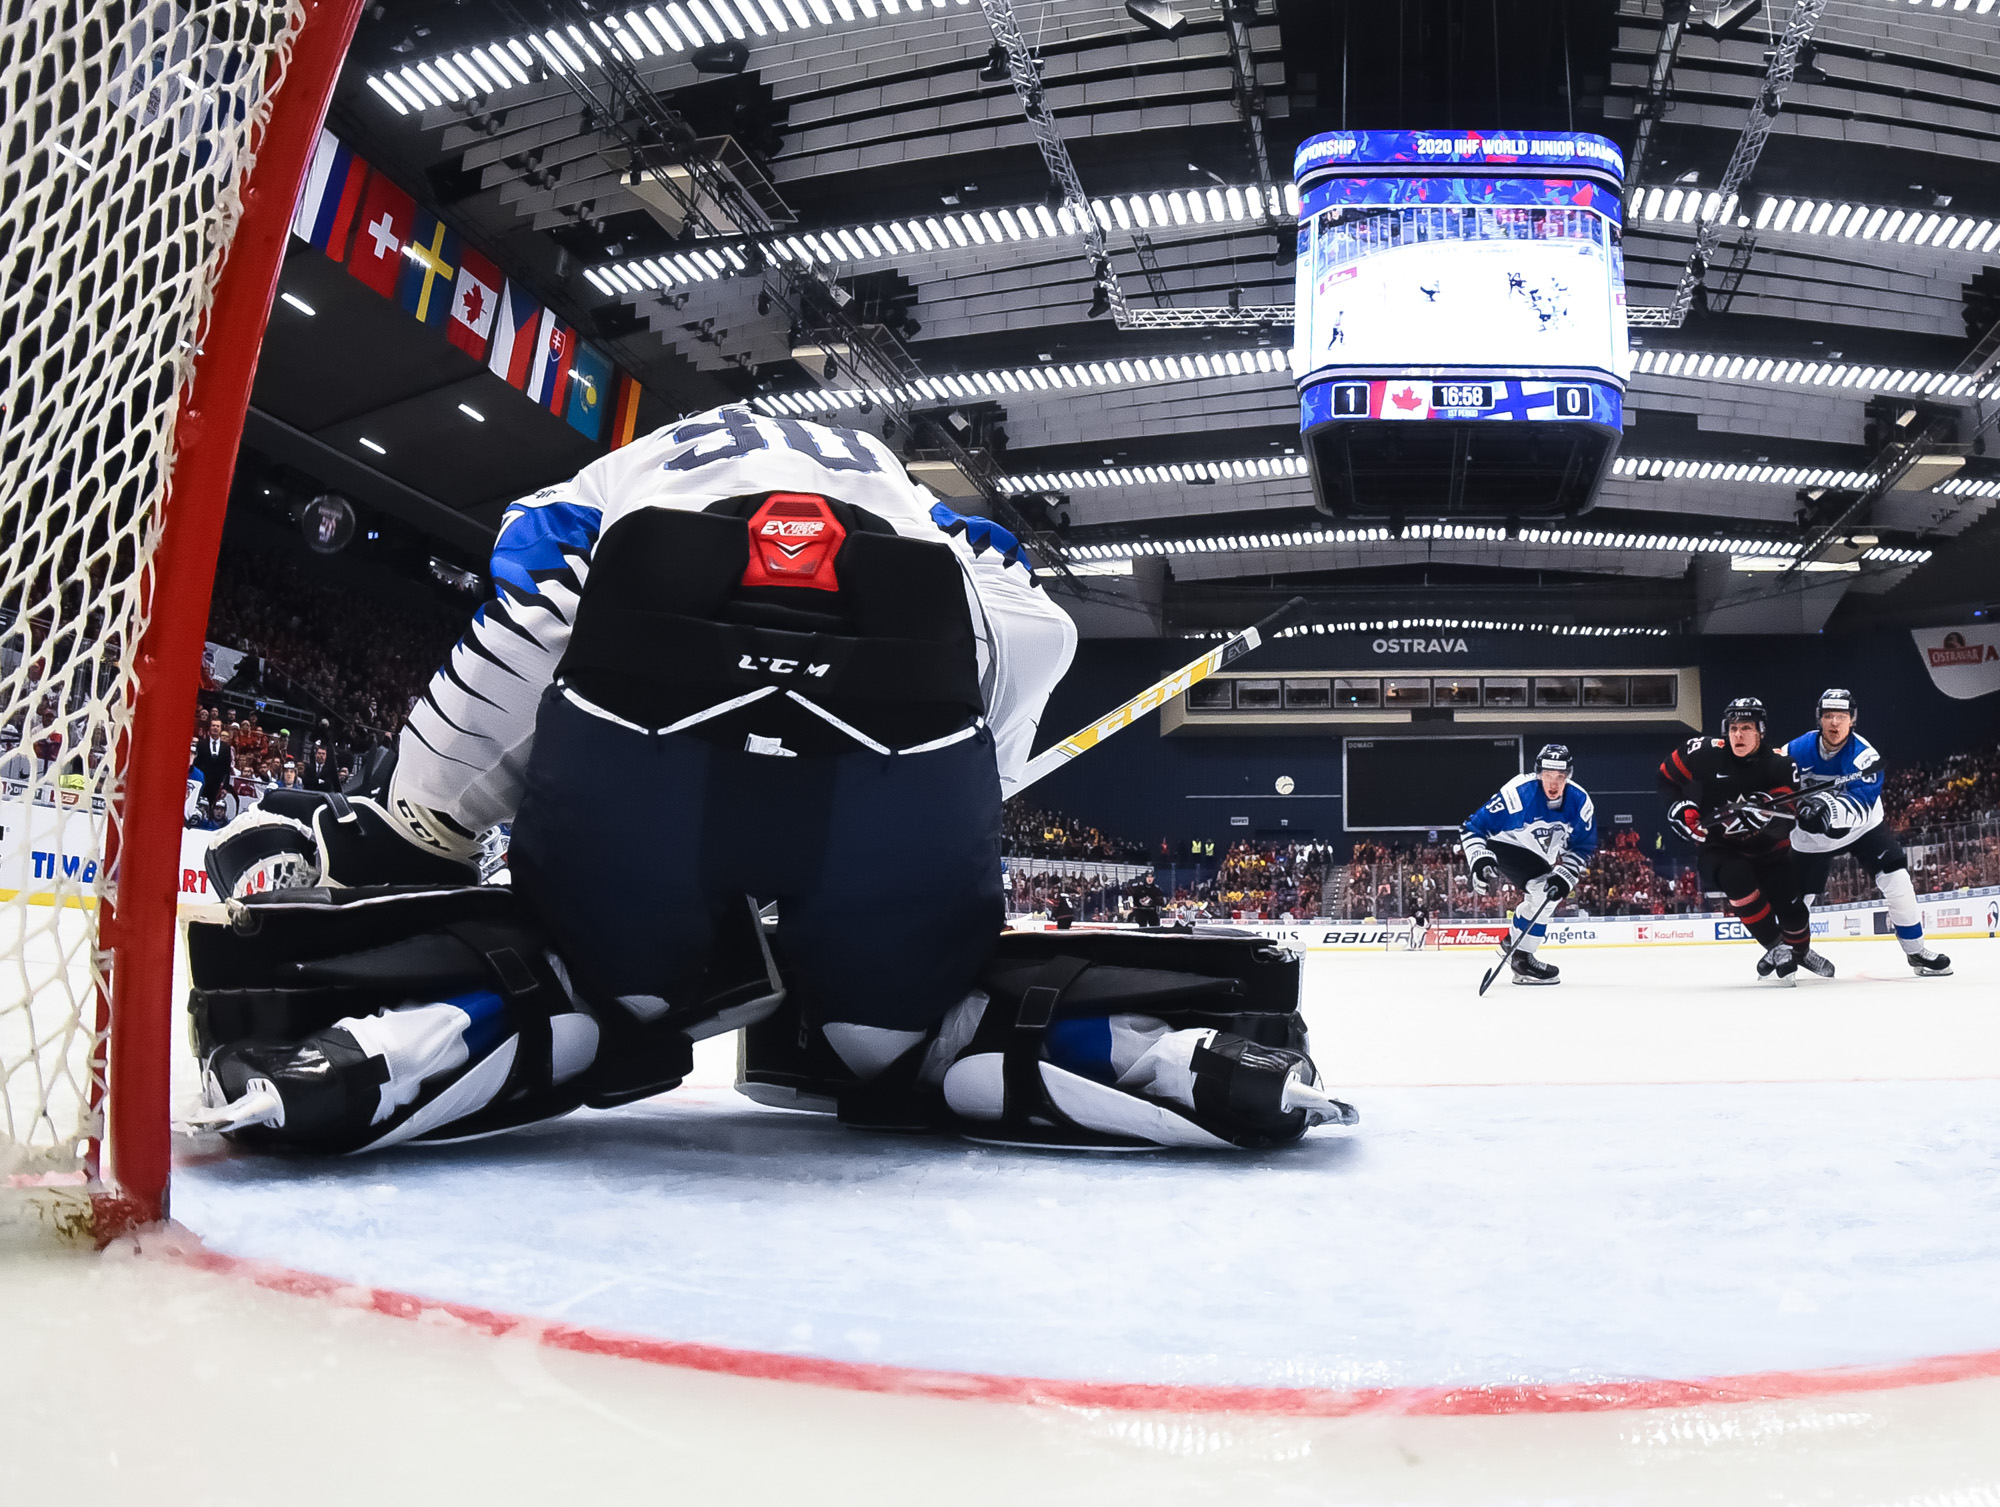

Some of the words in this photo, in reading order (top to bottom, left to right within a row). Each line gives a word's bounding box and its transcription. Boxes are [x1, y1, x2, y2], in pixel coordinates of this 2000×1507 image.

[1417, 138, 1452, 155] 2020
[1454, 138, 1480, 155] IIHF
[1481, 139, 1528, 156] WORLD
[1529, 139, 1575, 157] JUNIOR
[1346, 387, 1355, 412] 1
[1440, 386, 1484, 406] 16:58
[1566, 388, 1581, 413] 0
[1372, 638, 1469, 653] OSTRAVA
[1096, 671, 1193, 742] CCM
[1322, 931, 1410, 944] BAUER
[1433, 930, 1455, 944] Tim
[1455, 929, 1501, 944] Hortons
[1542, 930, 1596, 944] yngenta
[1654, 929, 1694, 940] Kaufland
